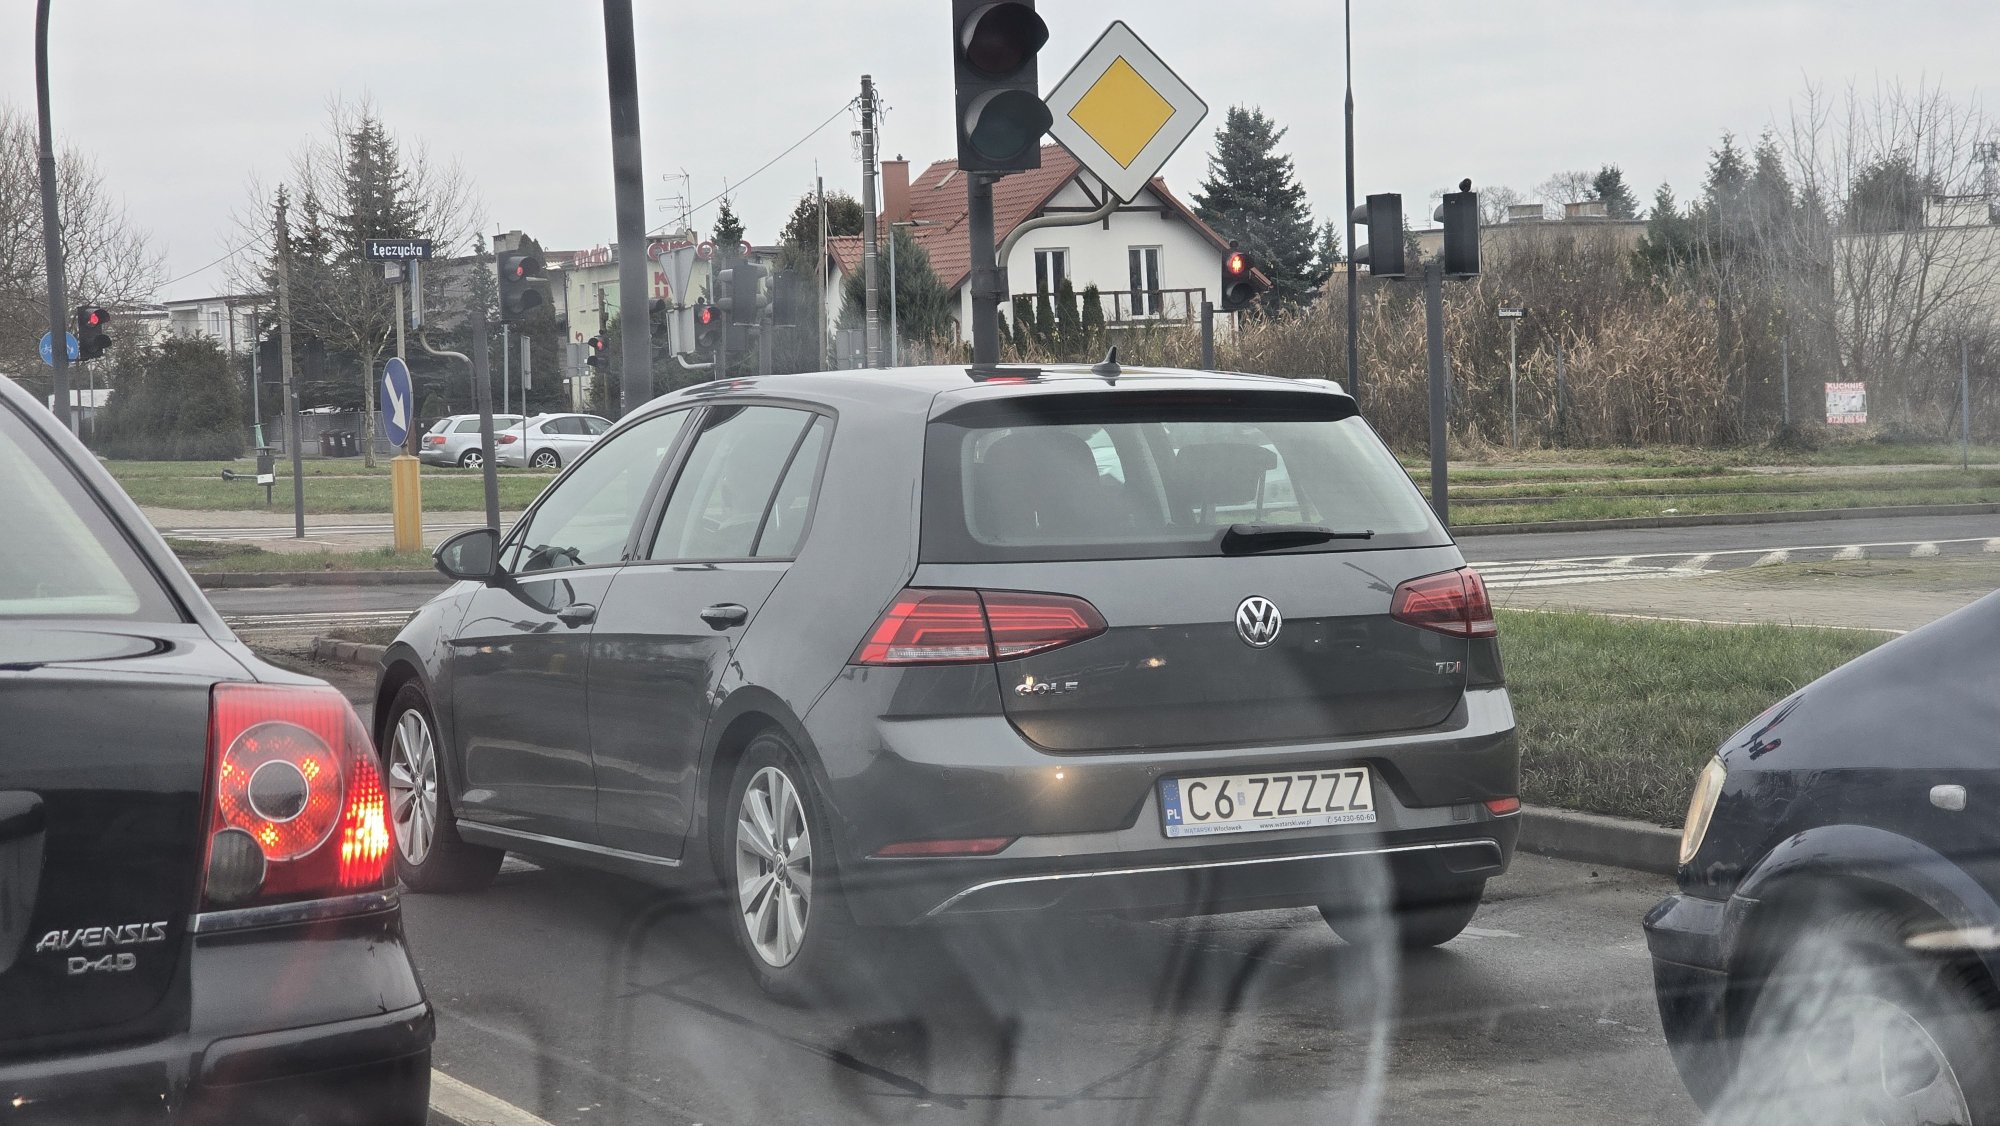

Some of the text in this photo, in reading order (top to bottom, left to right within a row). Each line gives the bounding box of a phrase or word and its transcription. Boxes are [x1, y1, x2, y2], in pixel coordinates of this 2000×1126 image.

[372, 242, 423, 258] Łęczycka
[1435, 661, 1461, 675] TDI
[1014, 681, 1079, 695] GOLF
[1187, 771, 1368, 821] C6 ZZZZZ
[1166, 808, 1181, 820] PL
[36, 921, 168, 952] AVENSIS
[67, 952, 137, 975] D-4D
